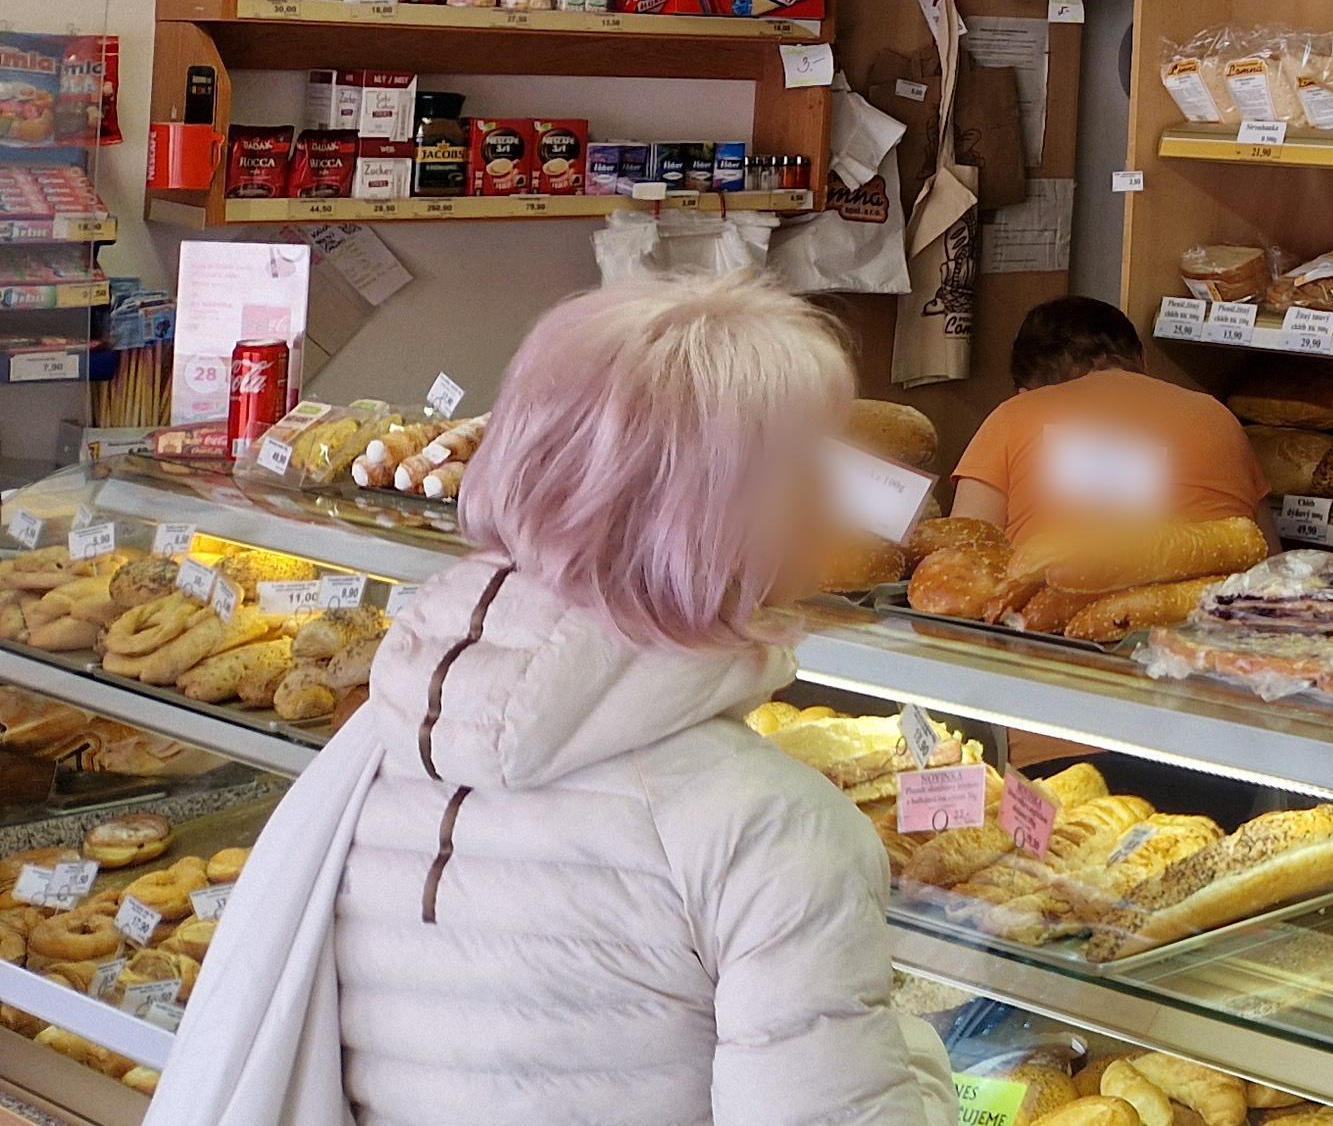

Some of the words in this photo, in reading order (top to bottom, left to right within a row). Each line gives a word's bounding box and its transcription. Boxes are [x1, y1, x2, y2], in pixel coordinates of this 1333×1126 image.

[421, 149, 464, 160] JACOBS
[1251, 147, 1272, 158] 21,90
[239, 157, 275, 168] ROCCA
[310, 158, 343, 168] ROCCA
[1223, 330, 1243, 341] 13,90
[1300, 337, 1321, 348] 29,90
[194, 367, 216, 382] 28
[1298, 499, 1315, 508] Chléb
